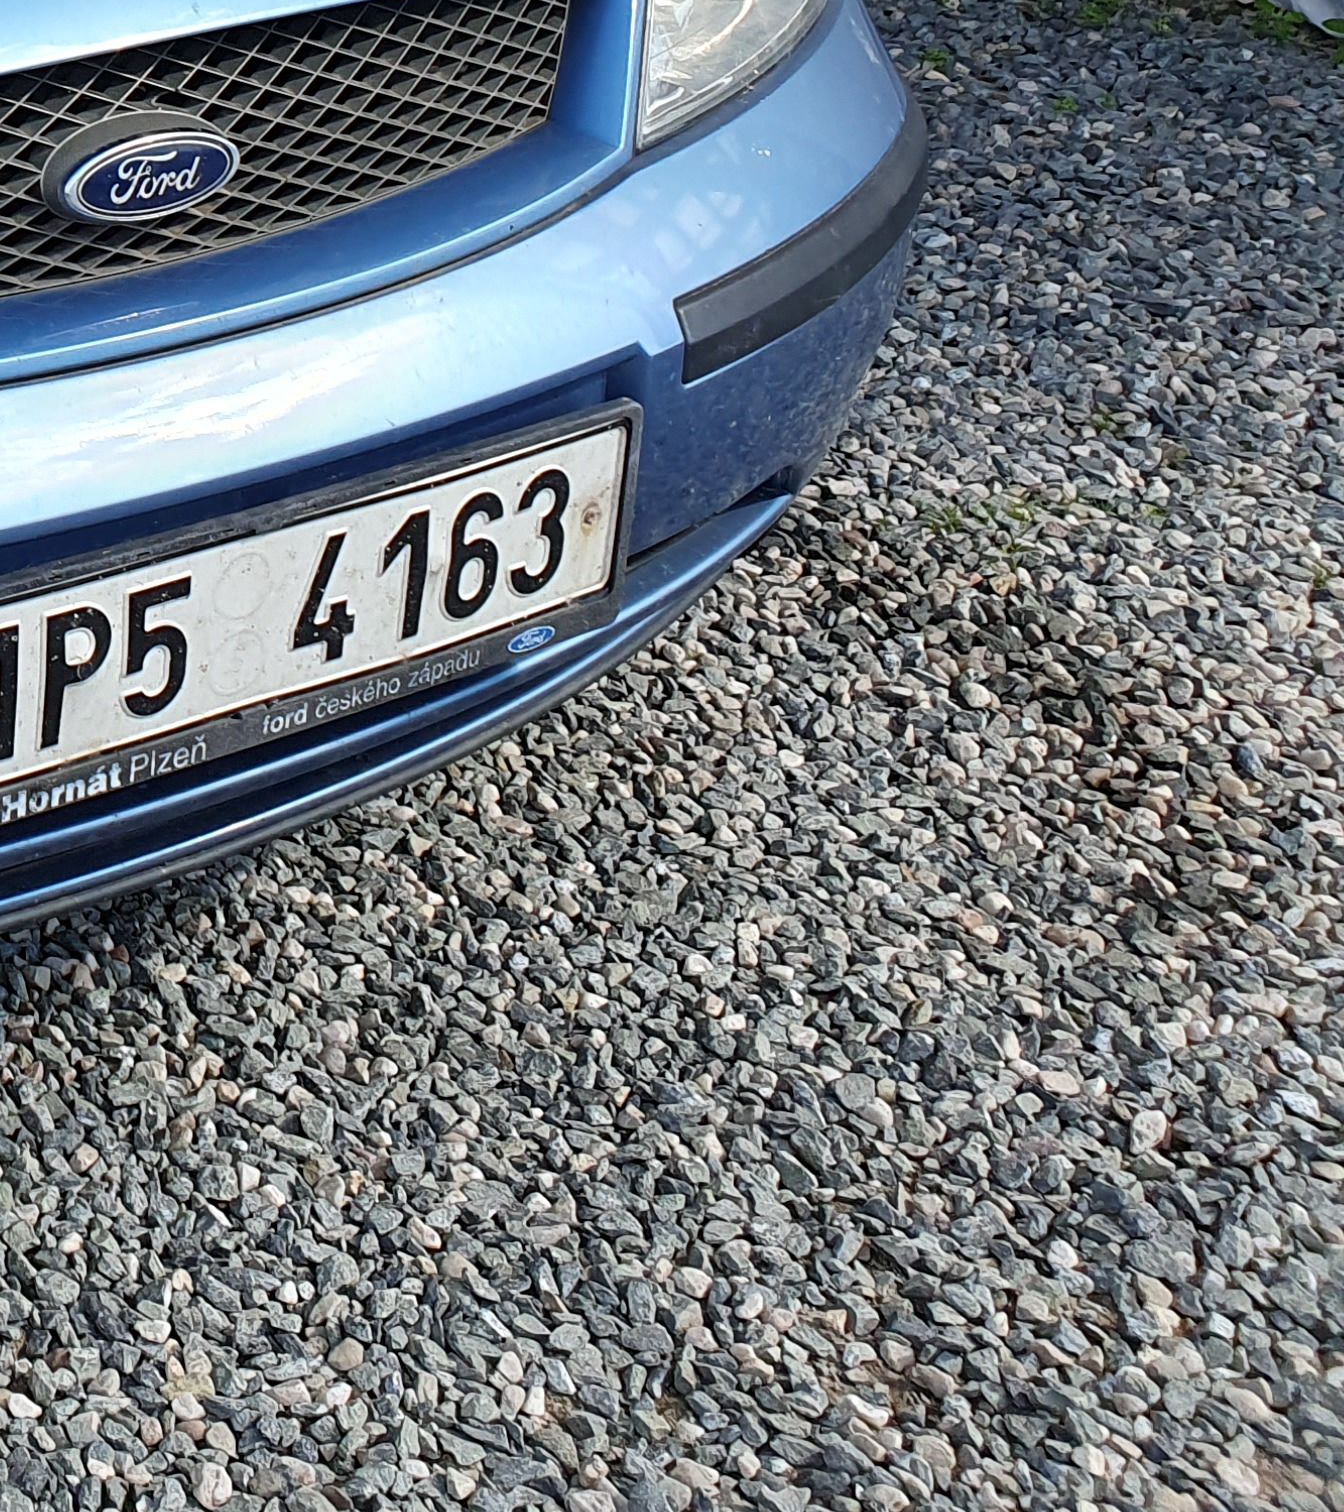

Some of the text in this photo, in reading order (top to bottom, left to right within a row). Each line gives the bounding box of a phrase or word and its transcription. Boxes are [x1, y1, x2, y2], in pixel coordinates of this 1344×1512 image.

[290, 465, 572, 664] 4163
[314, 675, 402, 720] českého
[407, 646, 481, 690] západu
[0, 735, 209, 824] Hornát Plzeň
